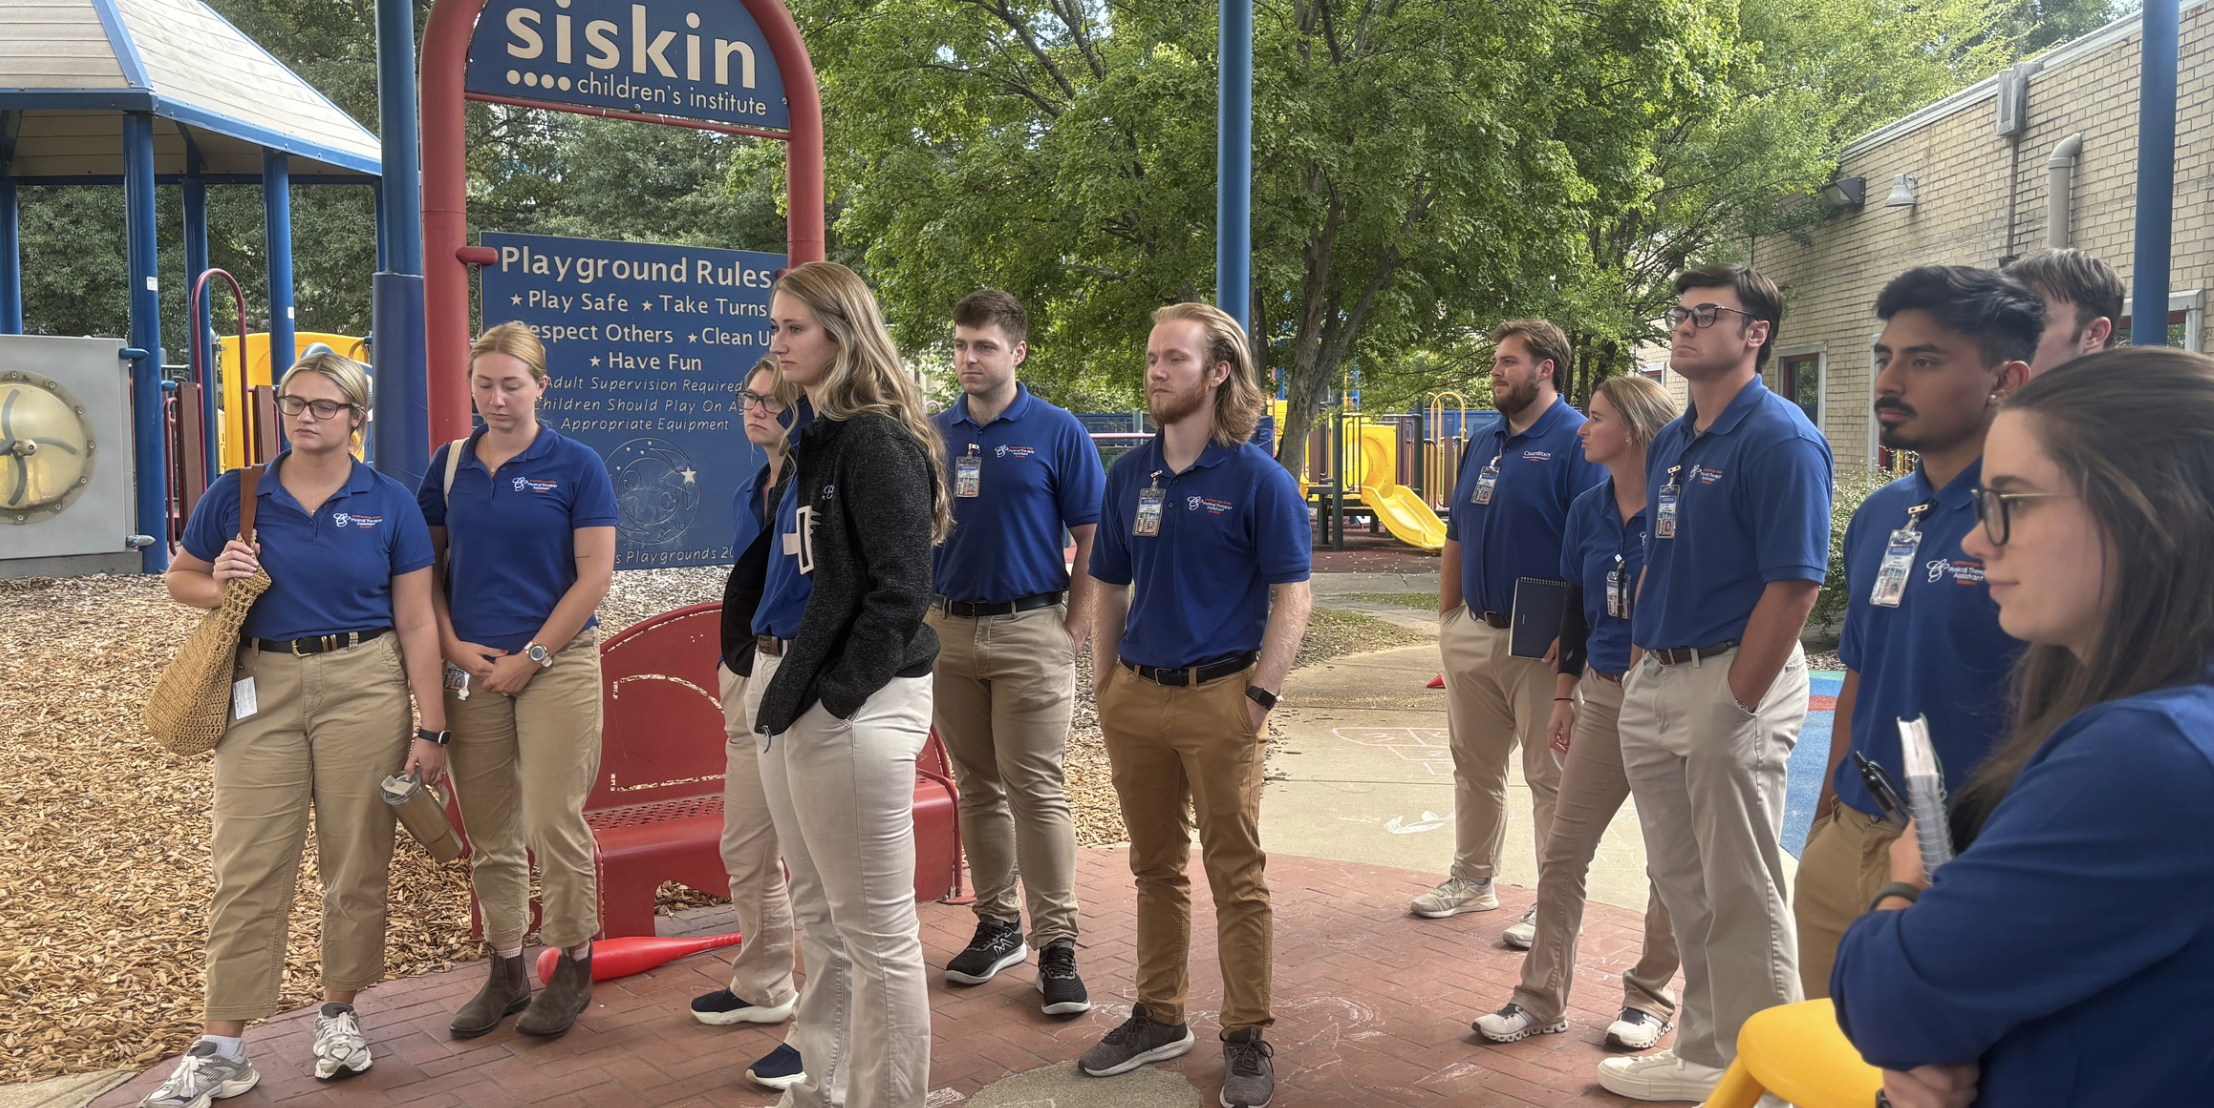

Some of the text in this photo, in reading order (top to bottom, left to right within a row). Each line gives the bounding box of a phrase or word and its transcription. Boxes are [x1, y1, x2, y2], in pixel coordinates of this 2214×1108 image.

[505, 0, 756, 89] siskin
[577, 71, 767, 116] children's institute
[501, 246, 772, 288] Playground Rules
[528, 290, 767, 317] Play Safe Take Turns
[513, 320, 599, 343] espect
[605, 323, 674, 344] Others
[701, 327, 753, 346] Clean
[609, 352, 702, 371] Have Fun
[591, 376, 677, 393] Supervision
[682, 379, 742, 394] Required
[535, 397, 601, 411] hildren
[607, 398, 658, 412] Should
[665, 399, 696, 414] Play
[703, 399, 722, 412] On
[560, 417, 730, 433] Appropriate Equipment
[626, 546, 717, 565] Playgrounds
